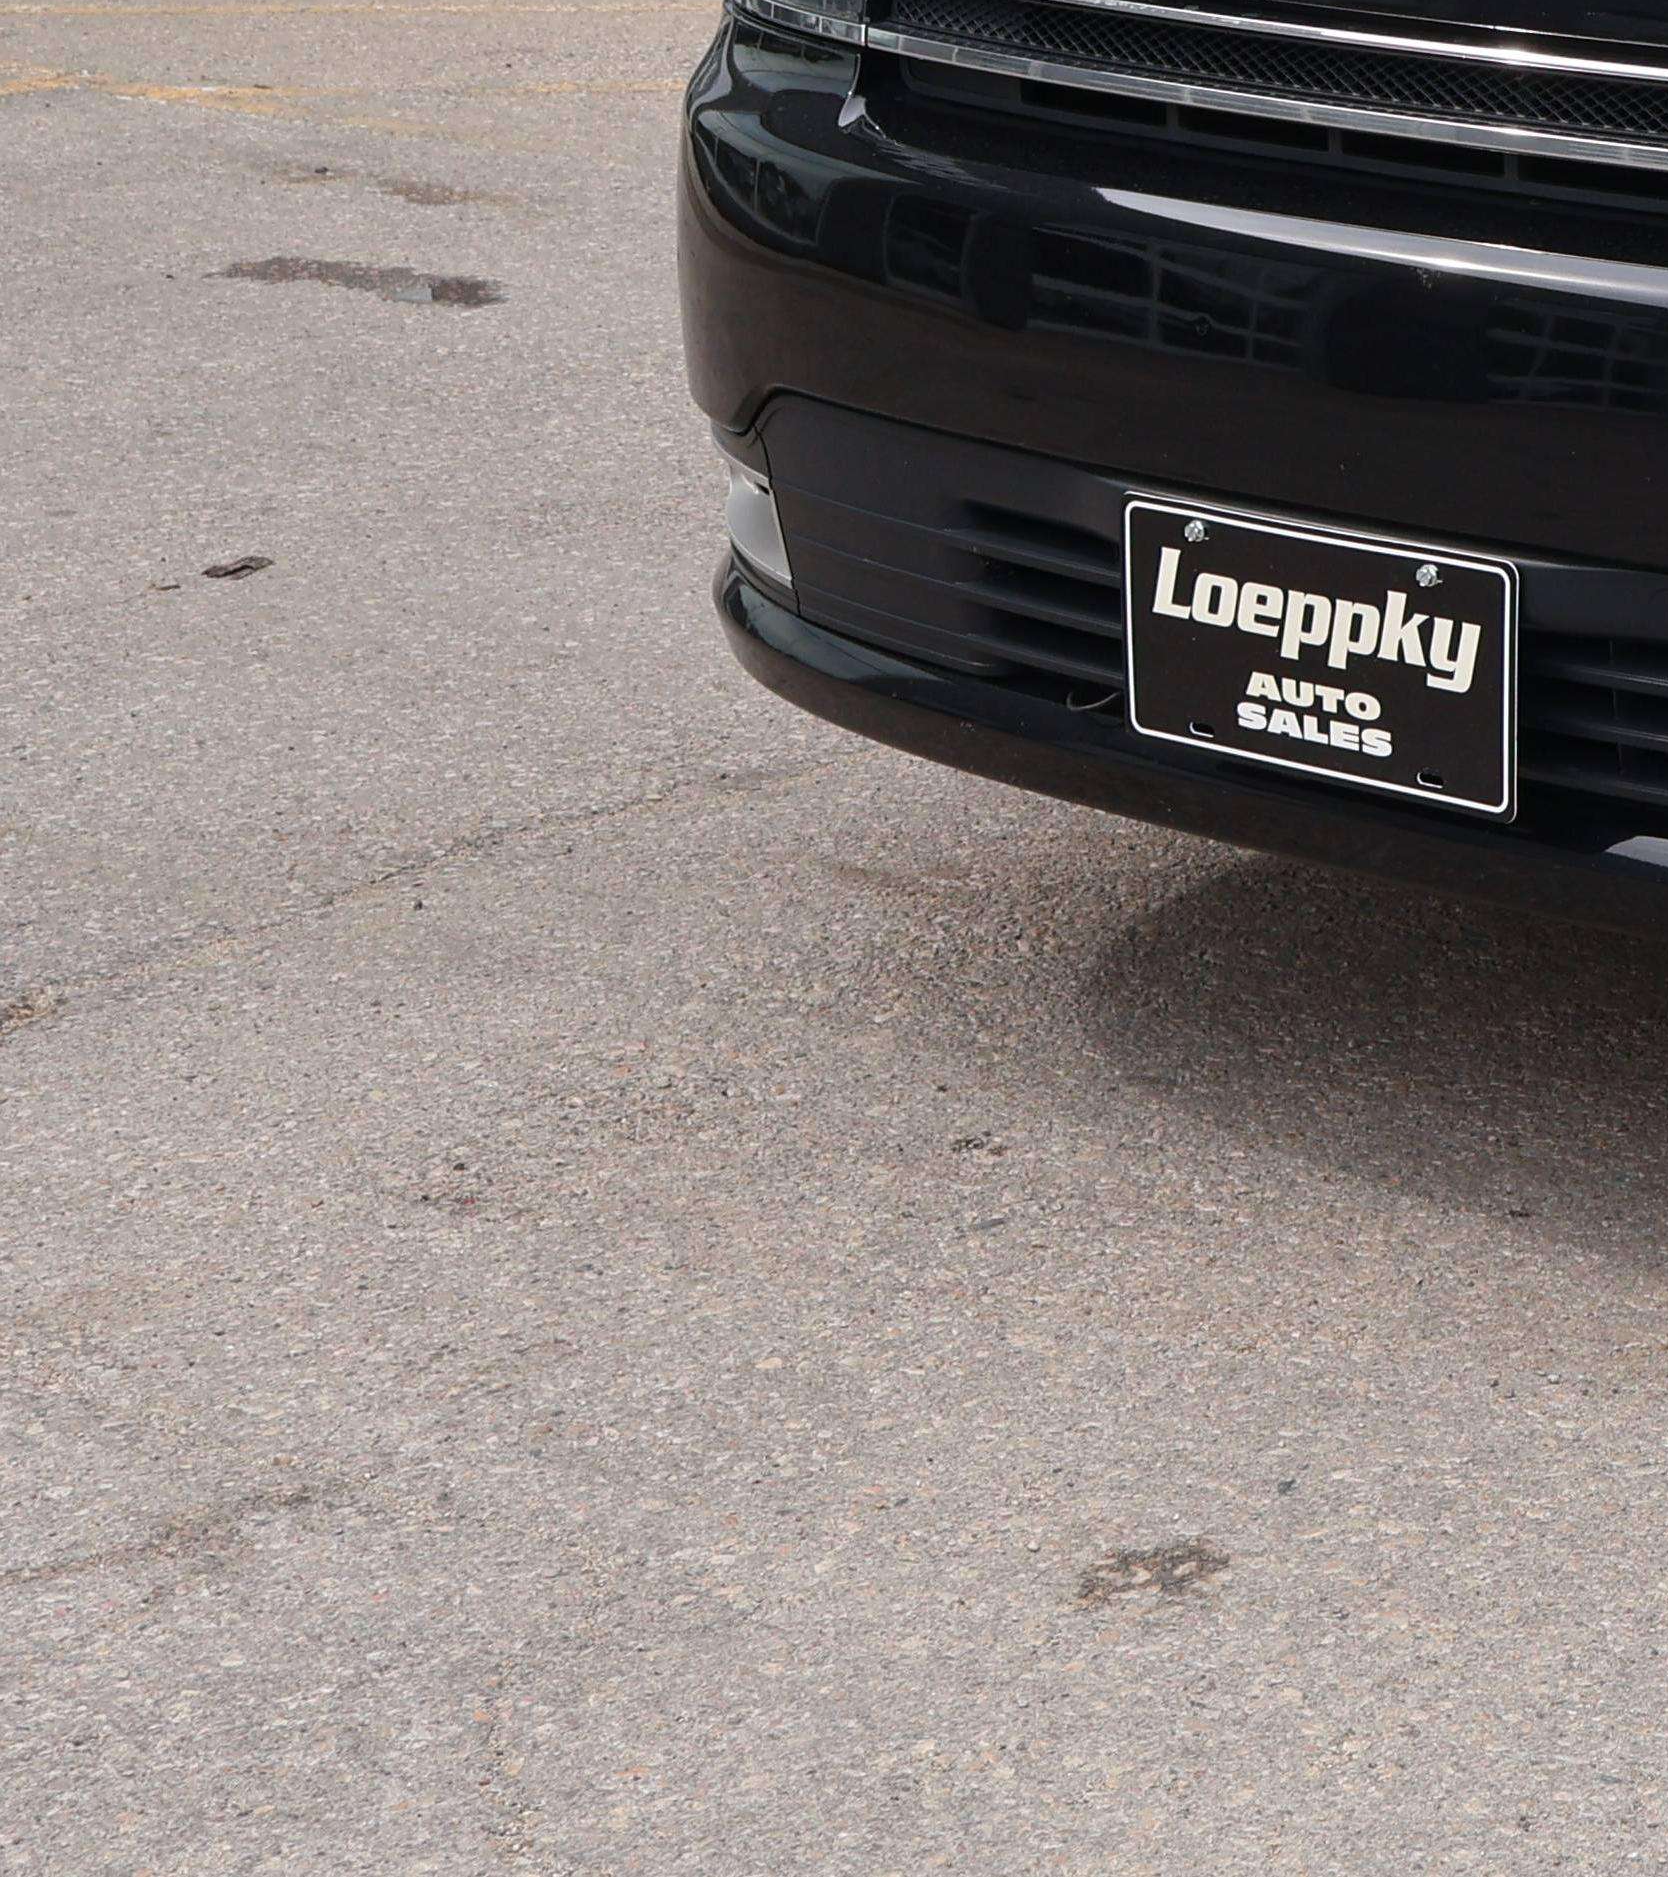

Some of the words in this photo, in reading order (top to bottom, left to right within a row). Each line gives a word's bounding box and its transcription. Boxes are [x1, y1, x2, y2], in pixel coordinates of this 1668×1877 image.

[1152, 546, 1481, 694] Loeppky
[1246, 672, 1382, 721] AUTO
[1237, 702, 1393, 758] SALES
